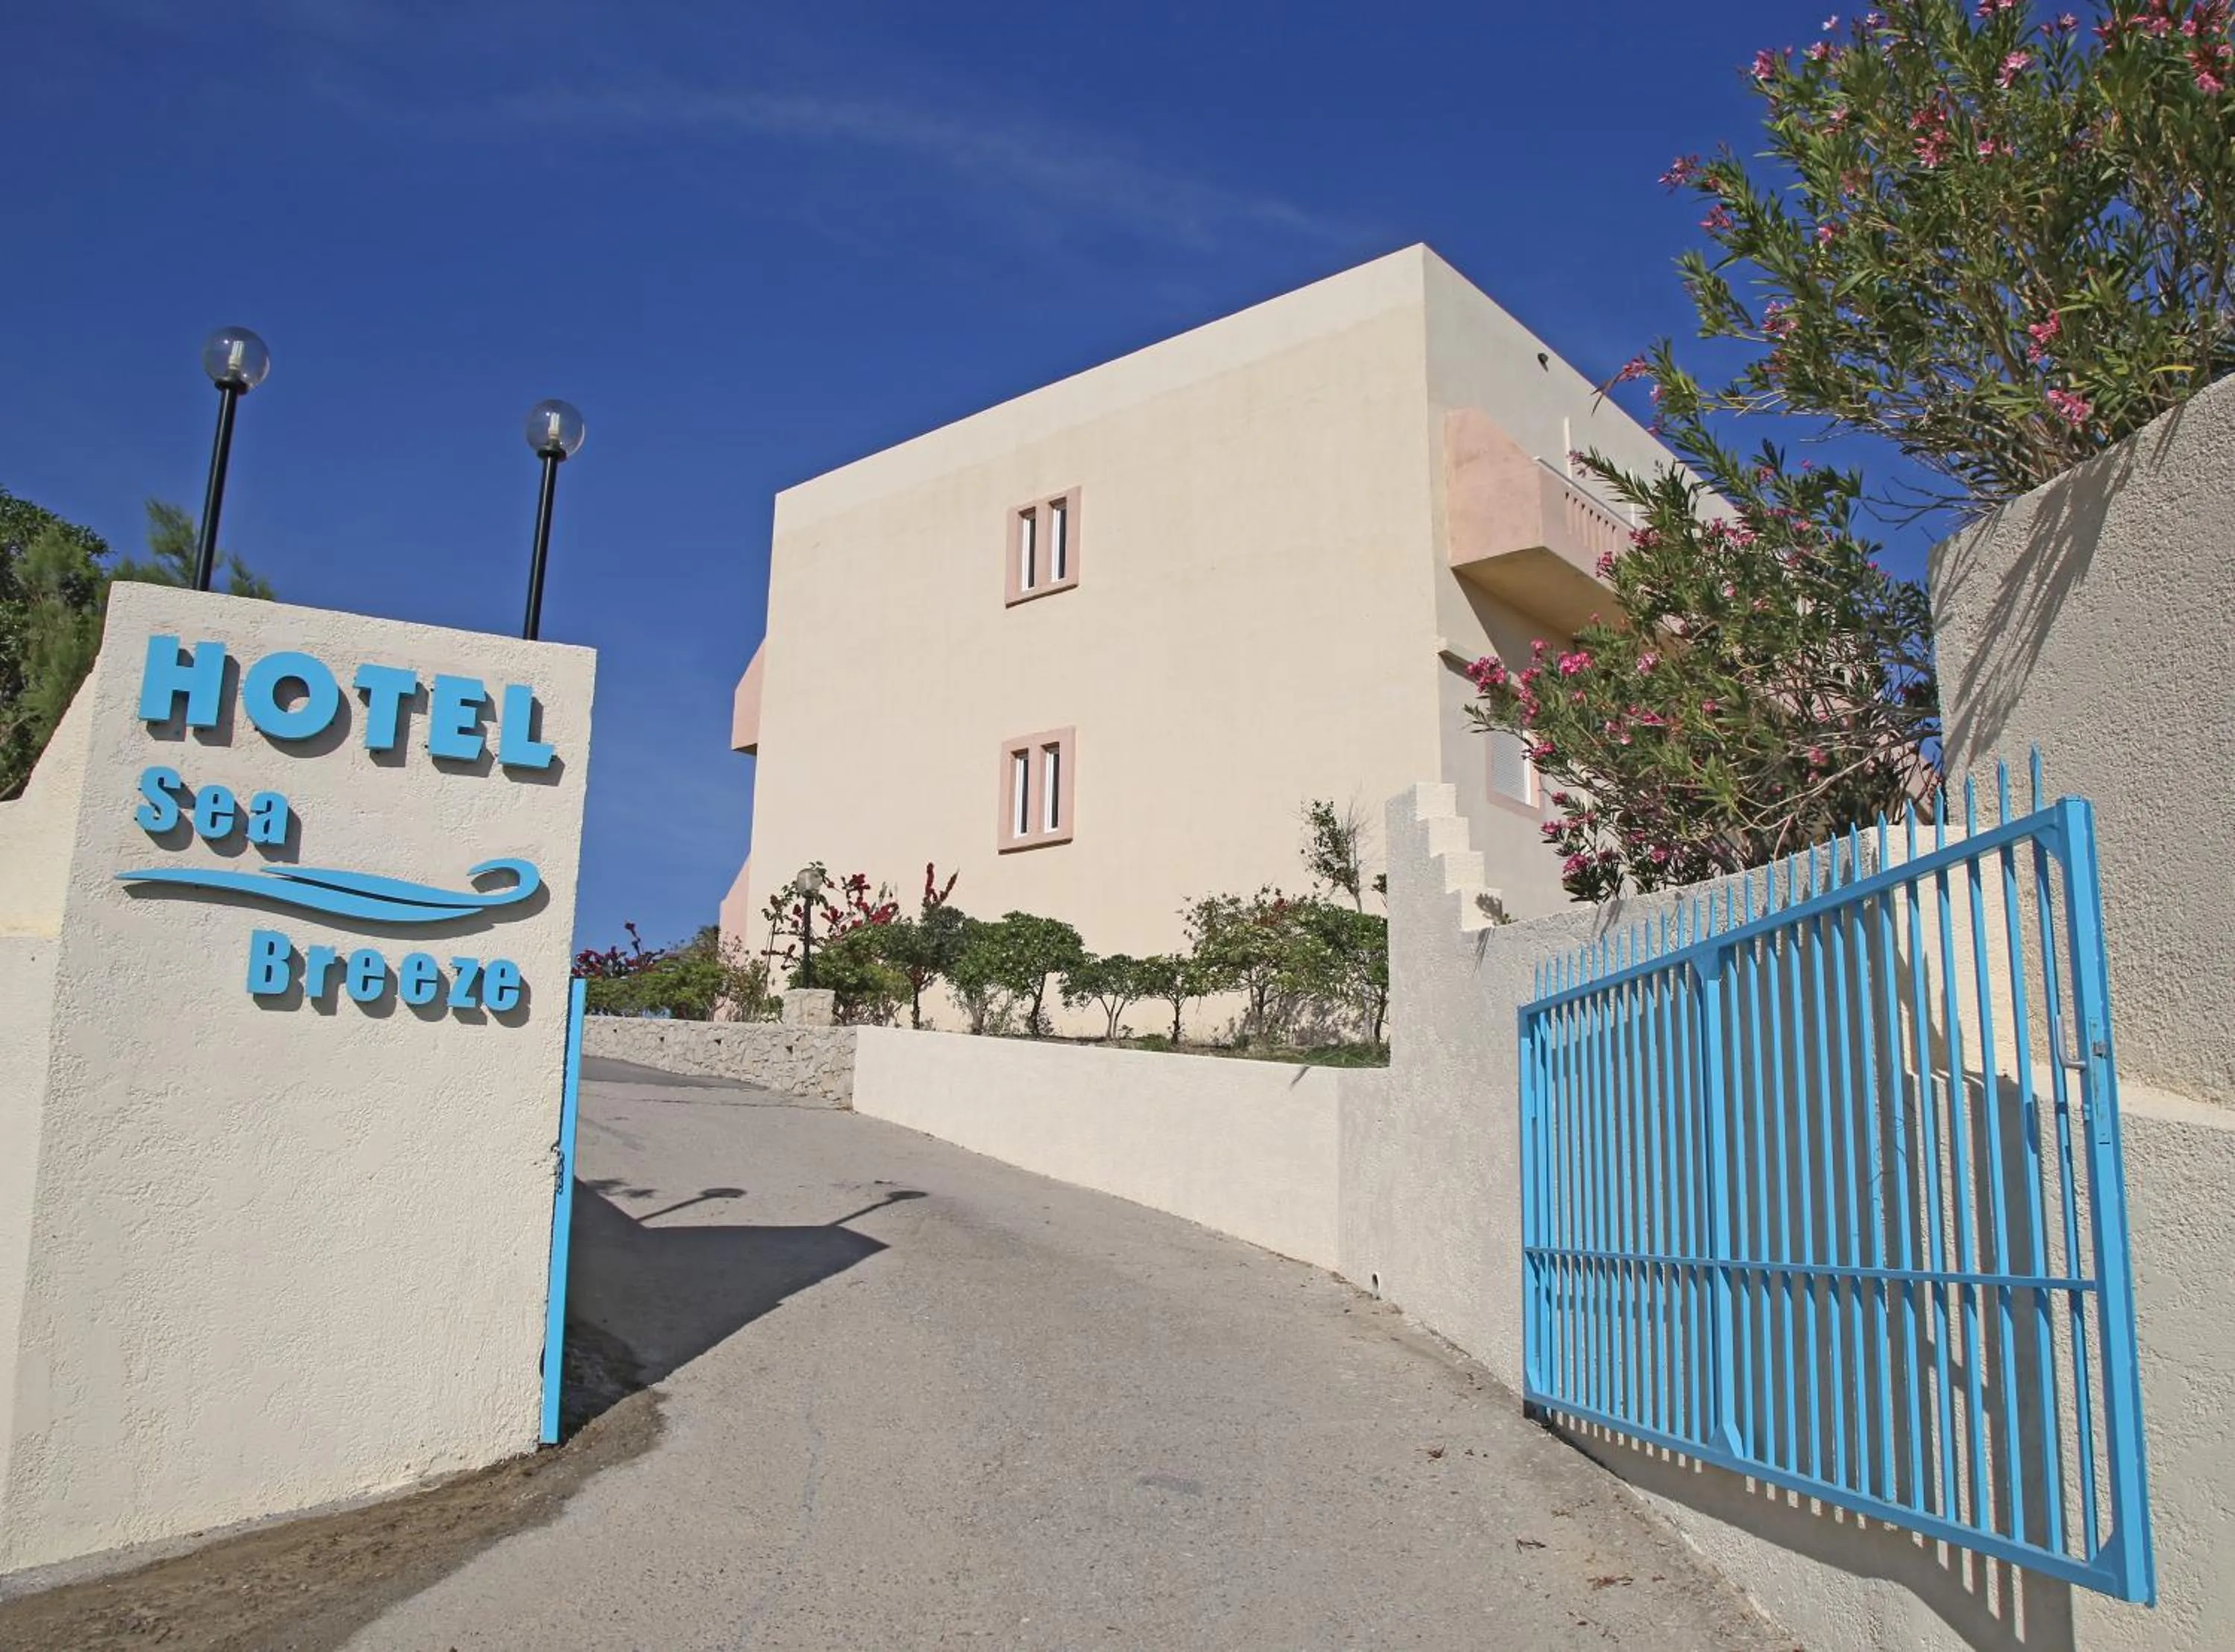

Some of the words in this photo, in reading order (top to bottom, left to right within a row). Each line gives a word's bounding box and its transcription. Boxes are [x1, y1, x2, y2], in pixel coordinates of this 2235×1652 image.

[139, 635, 555, 769] HOTEL
[136, 766, 290, 845] Sea
[247, 930, 522, 1011] Breeze
